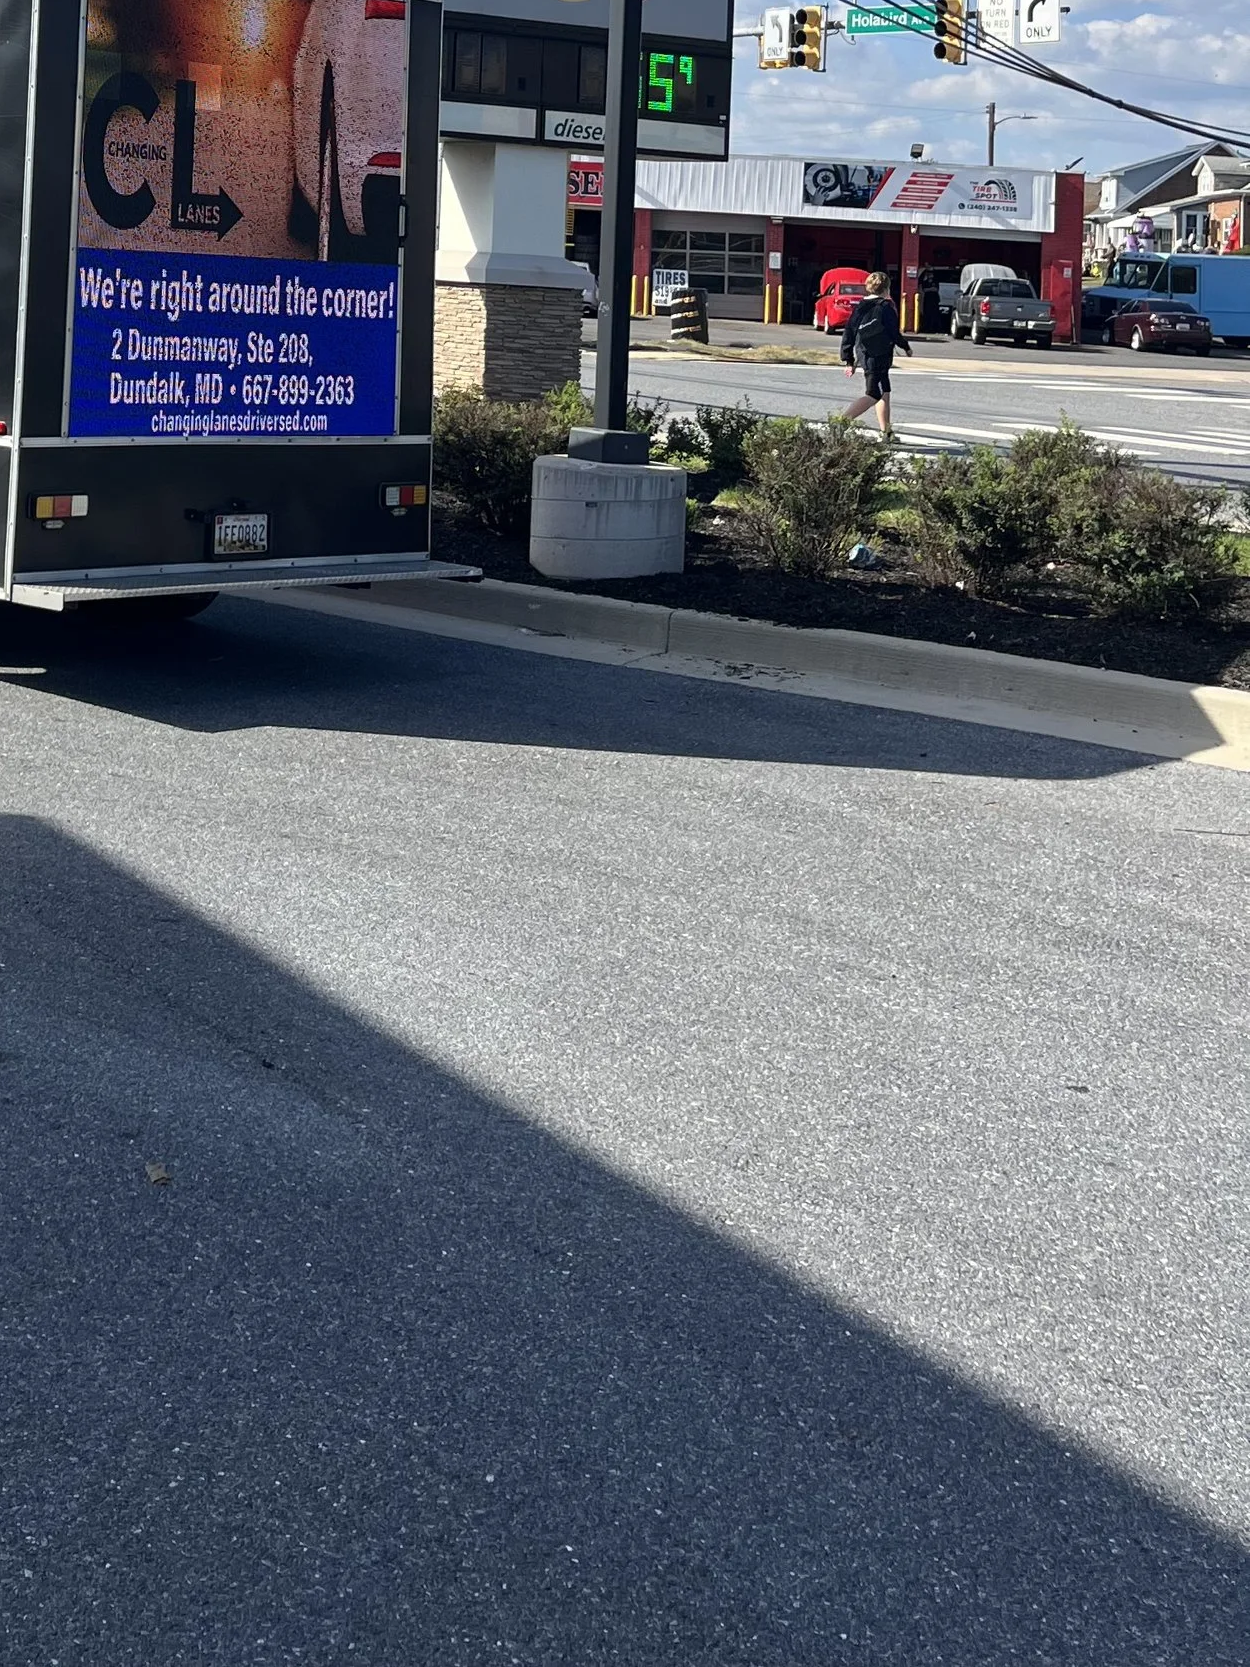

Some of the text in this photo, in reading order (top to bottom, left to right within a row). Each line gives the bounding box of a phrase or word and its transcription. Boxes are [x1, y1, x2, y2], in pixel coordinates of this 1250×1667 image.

[851, 11, 908, 28] Holabird
[985, 9, 1007, 18] TURN
[981, 19, 1010, 29] ON RED
[1026, 26, 1052, 39] ONLY
[767, 46, 783, 57] ONLY
[554, 118, 606, 141] diese
[108, 141, 167, 161] CHANGING
[568, 170, 604, 196] SE
[972, 185, 992, 193] TIRE
[177, 203, 221, 225] LANES
[655, 271, 686, 286] TIRES
[79, 266, 395, 322] We're right around the corner!
[111, 328, 313, 370] 2 Dunmanway, Ste 208,
[110, 372, 355, 408] Dundalk, MD 667-899-2363
[151, 409, 328, 437] changinglanesdriversed.com
